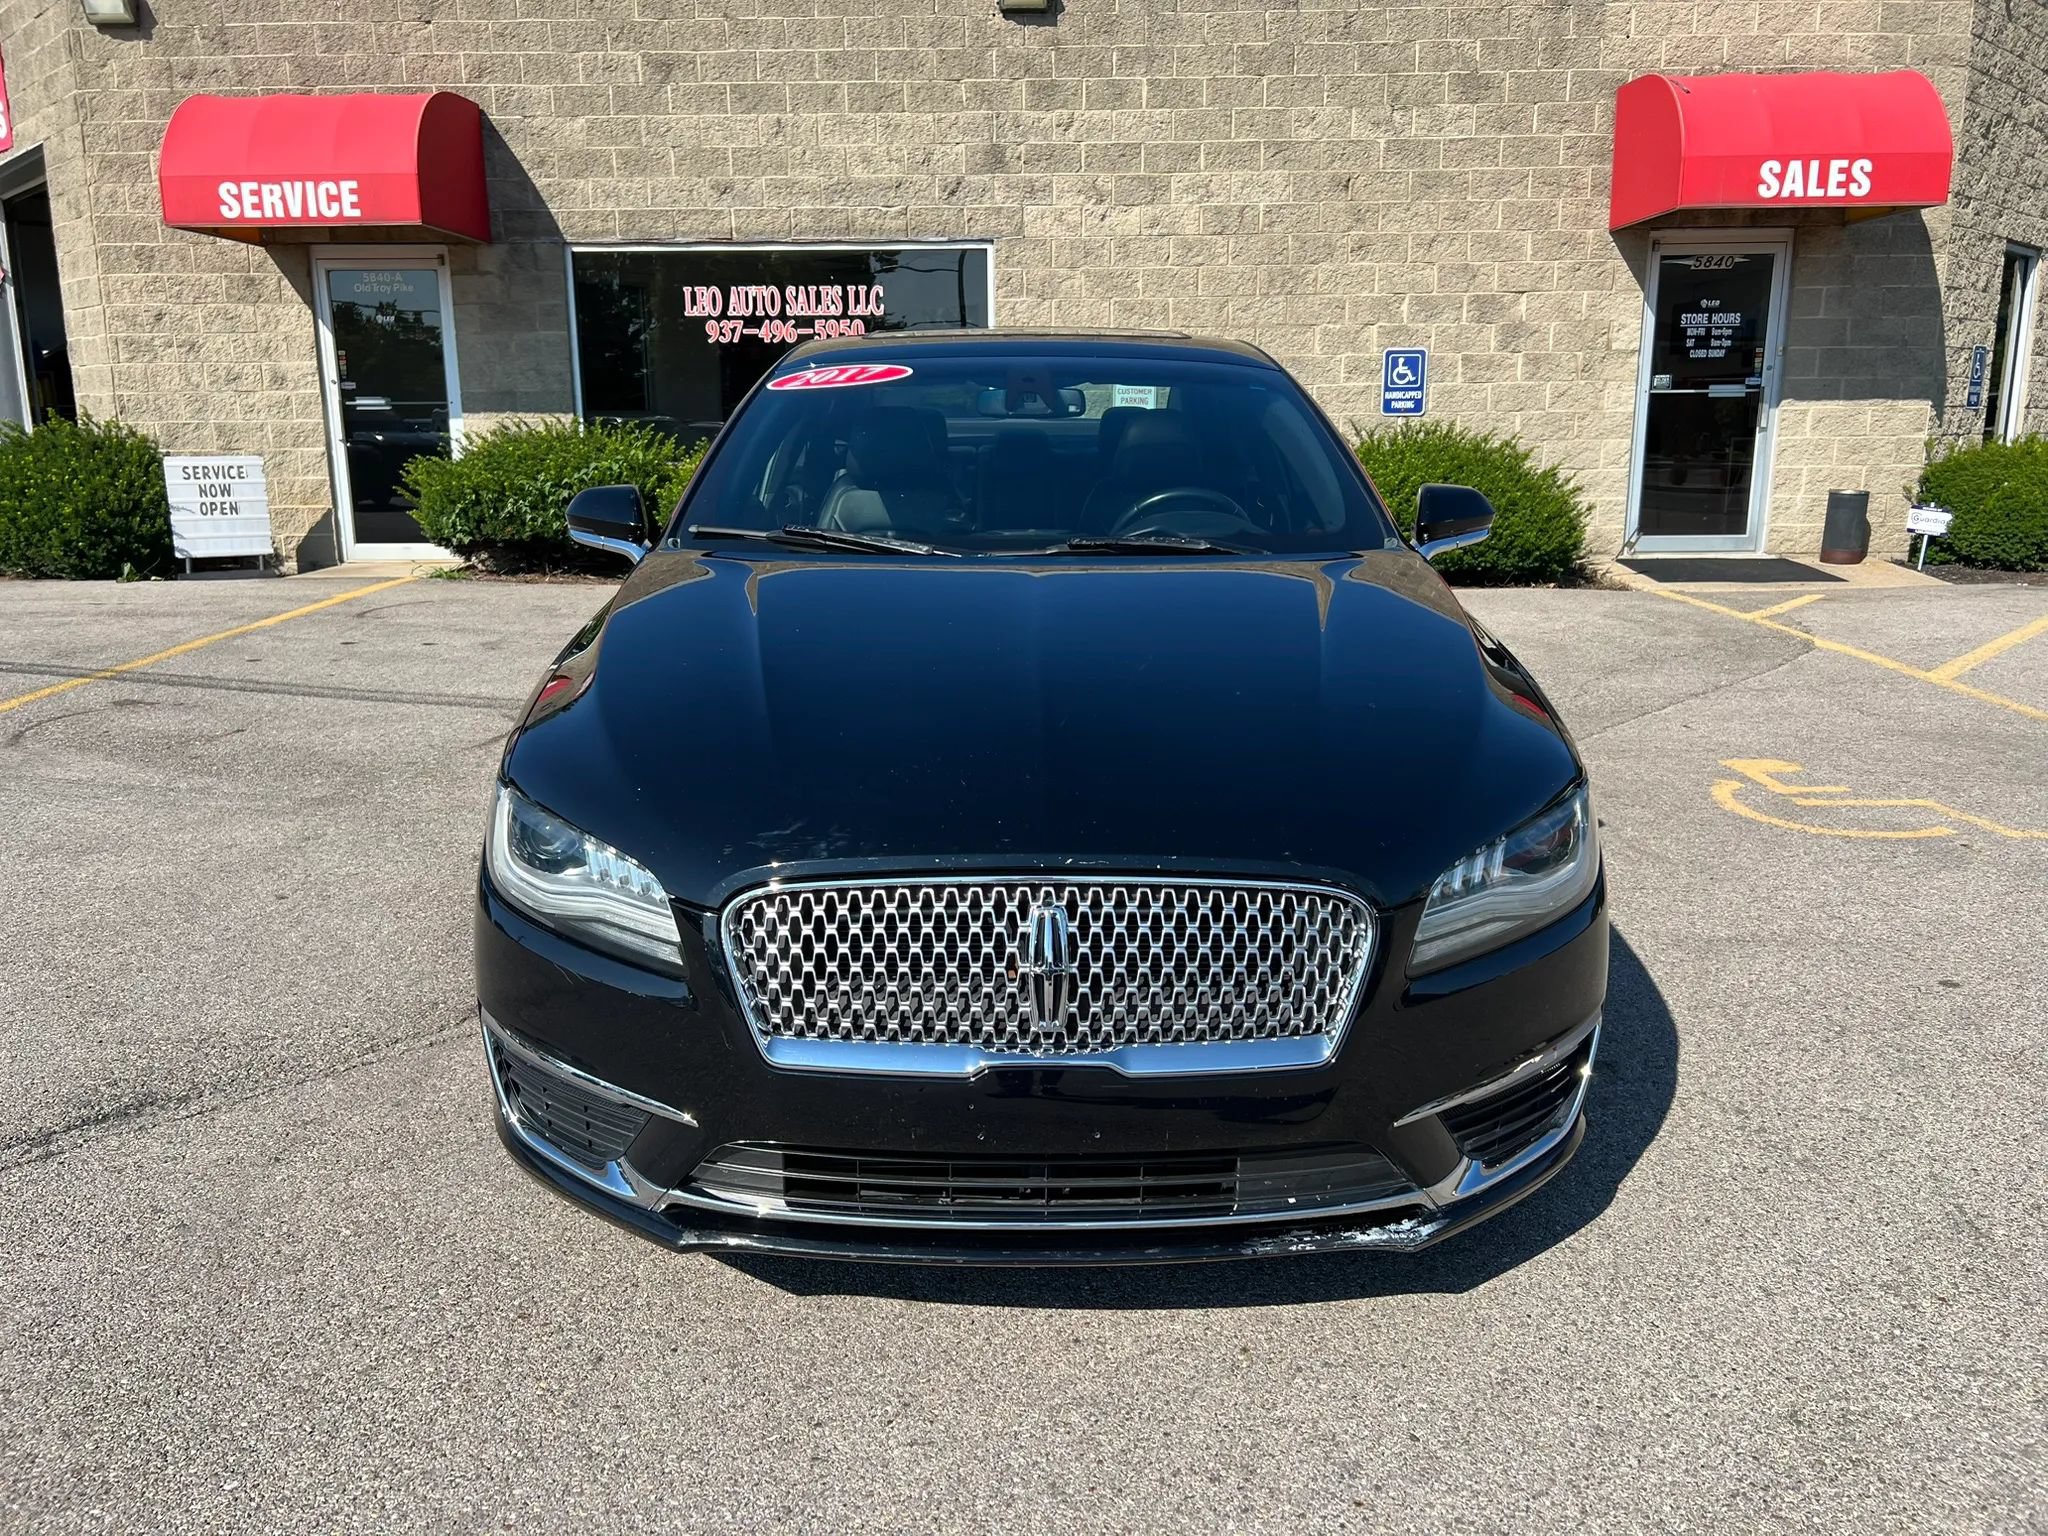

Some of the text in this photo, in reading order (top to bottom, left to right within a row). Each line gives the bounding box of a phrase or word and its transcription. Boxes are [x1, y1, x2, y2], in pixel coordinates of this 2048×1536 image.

[1757, 158, 1873, 199] SALES
[218, 180, 361, 219] SERVICE
[1694, 255, 1736, 269] 5840
[354, 283, 371, 293] Old
[373, 283, 392, 294] Troy
[683, 285, 885, 317] LEO AUTO SALES LLC
[1680, 313, 1741, 324] STORE HOURS
[705, 319, 866, 344] 937-496-5950
[786, 366, 887, 387] 2017
[1120, 397, 1149, 405] PARKING
[1384, 391, 1422, 399] HANDICAPPED
[182, 465, 246, 480] SERVICE
[198, 483, 231, 498] NOW
[199, 501, 239, 516] OPEN
